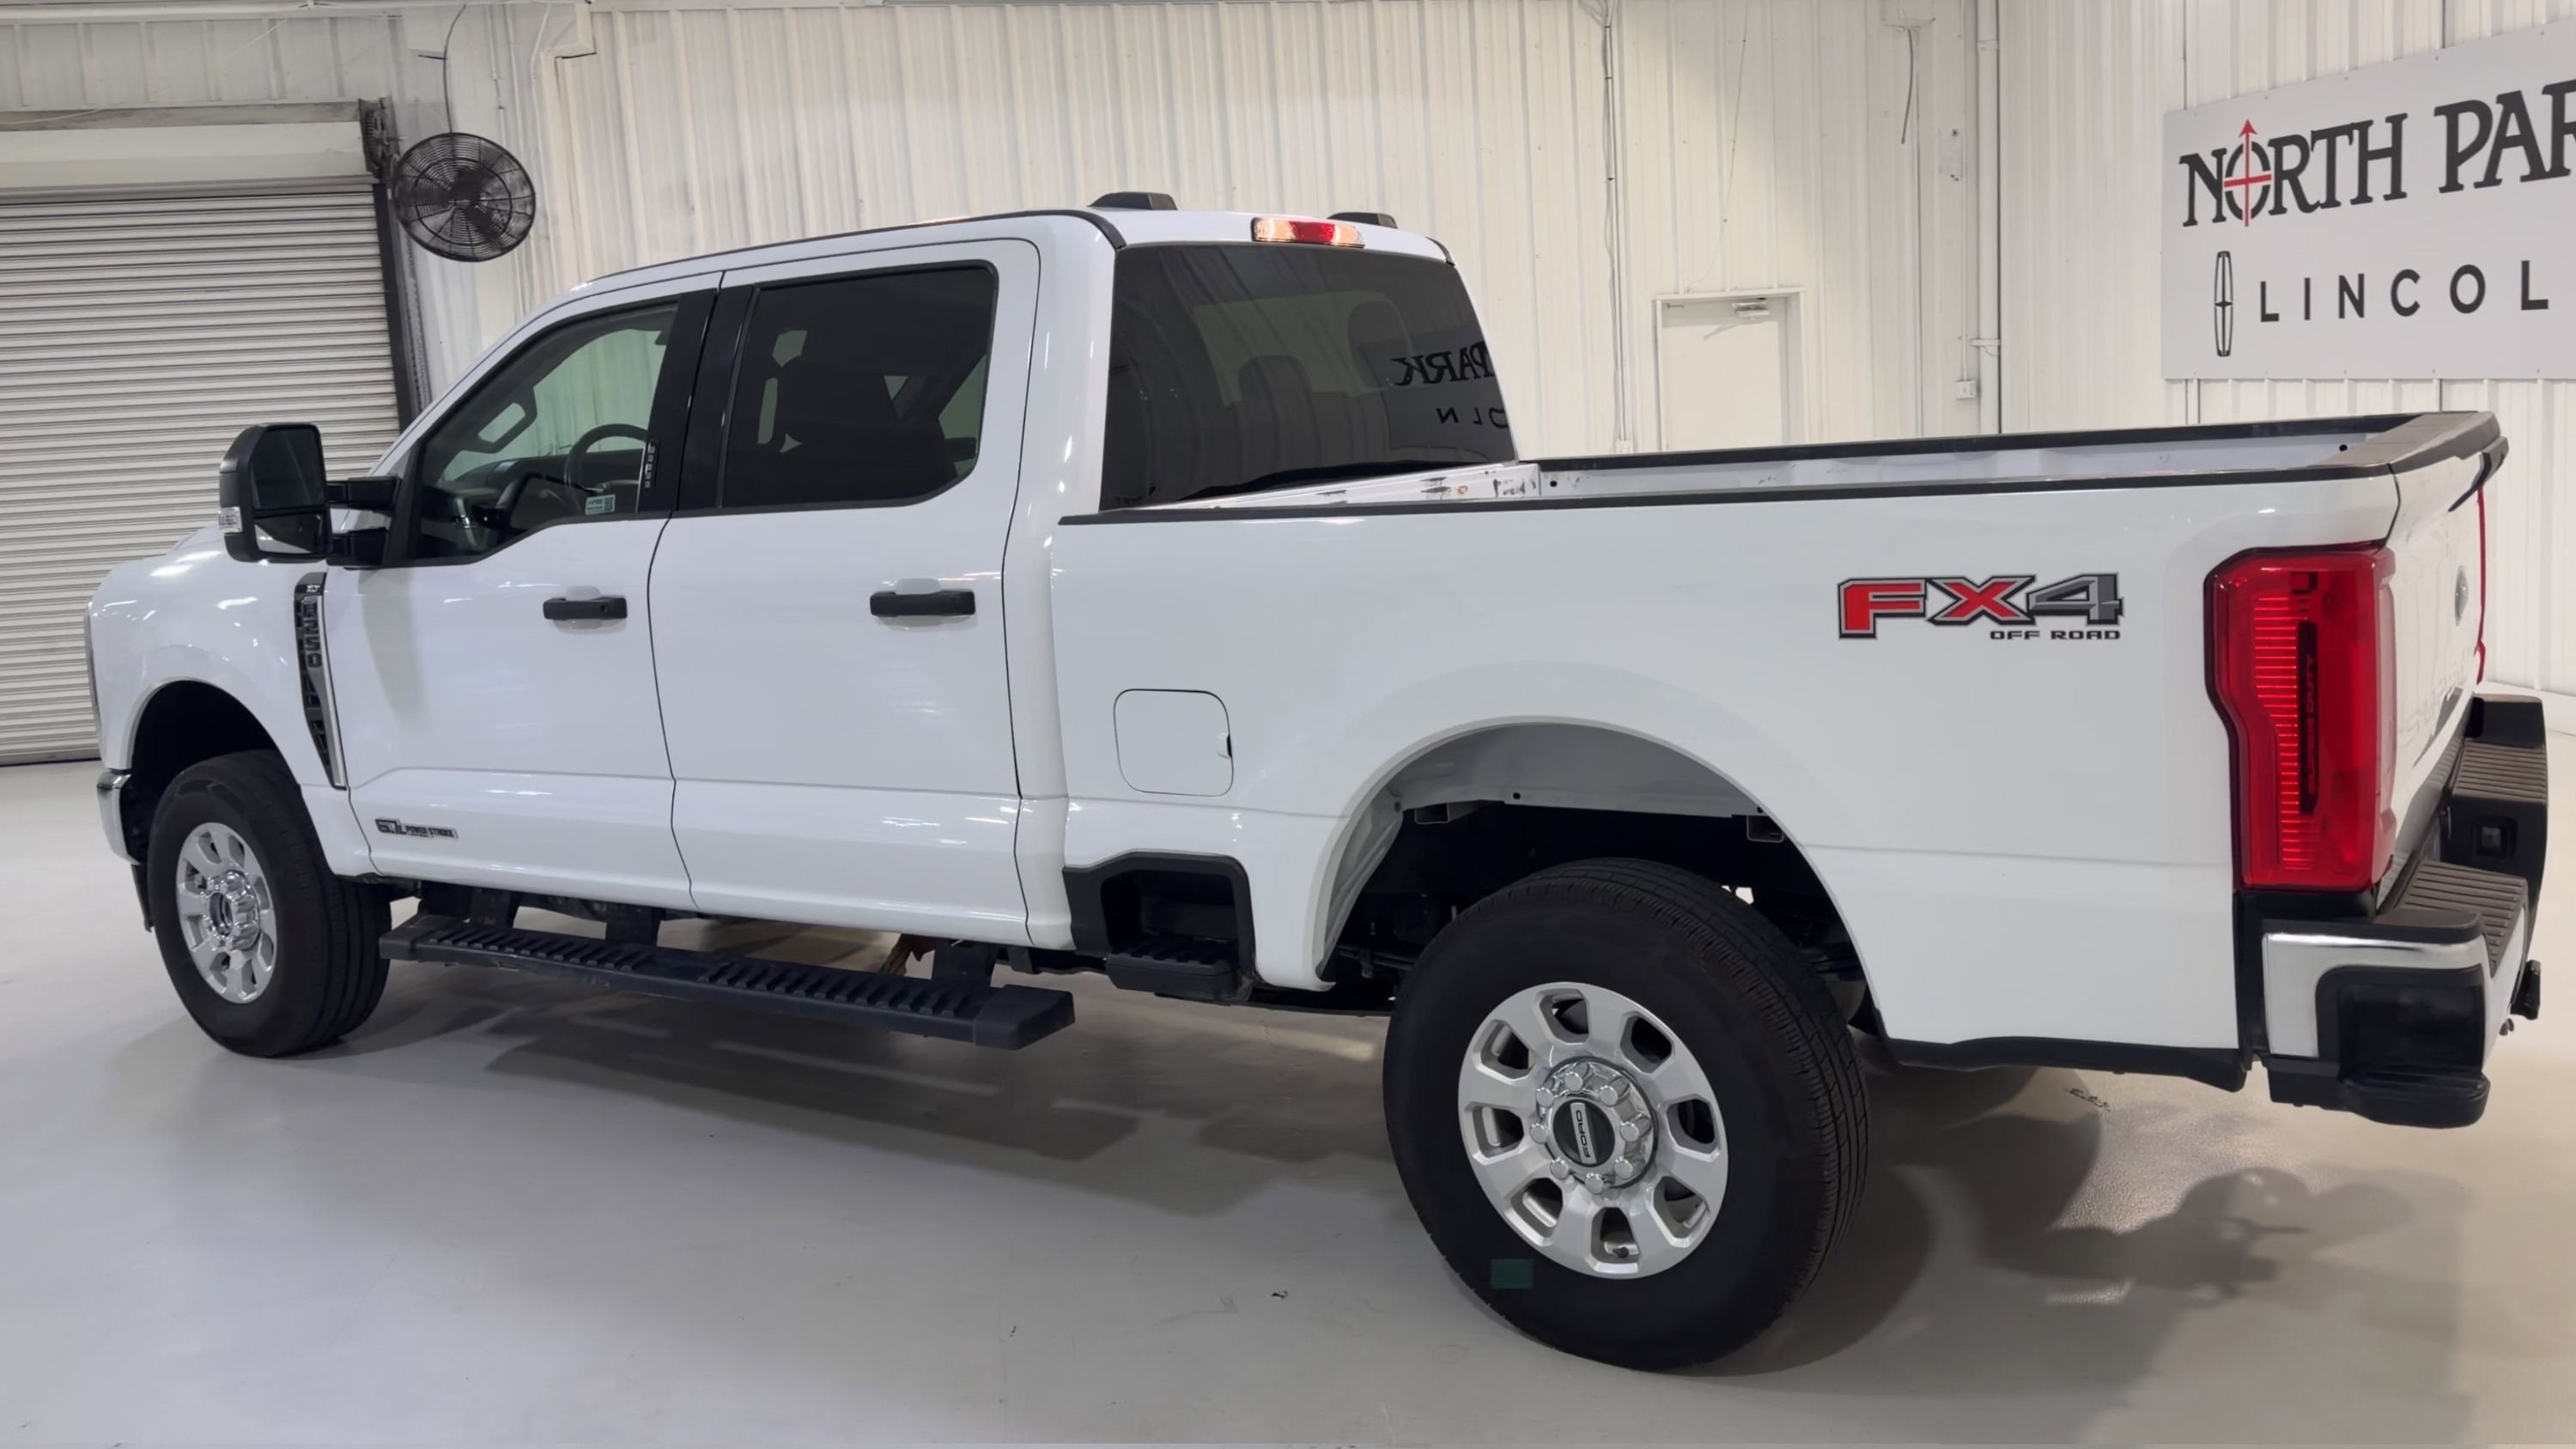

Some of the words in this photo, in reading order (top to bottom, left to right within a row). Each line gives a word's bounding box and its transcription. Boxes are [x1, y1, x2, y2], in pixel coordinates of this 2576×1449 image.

[2178, 112, 2408, 227] NORTH
[2259, 260, 2549, 323] LINCOL
[1838, 573, 2124, 640] FX4
[1990, 629, 2040, 640] OFF
[2050, 629, 2121, 640] ROAD
[1576, 1109, 1591, 1158] FORD
